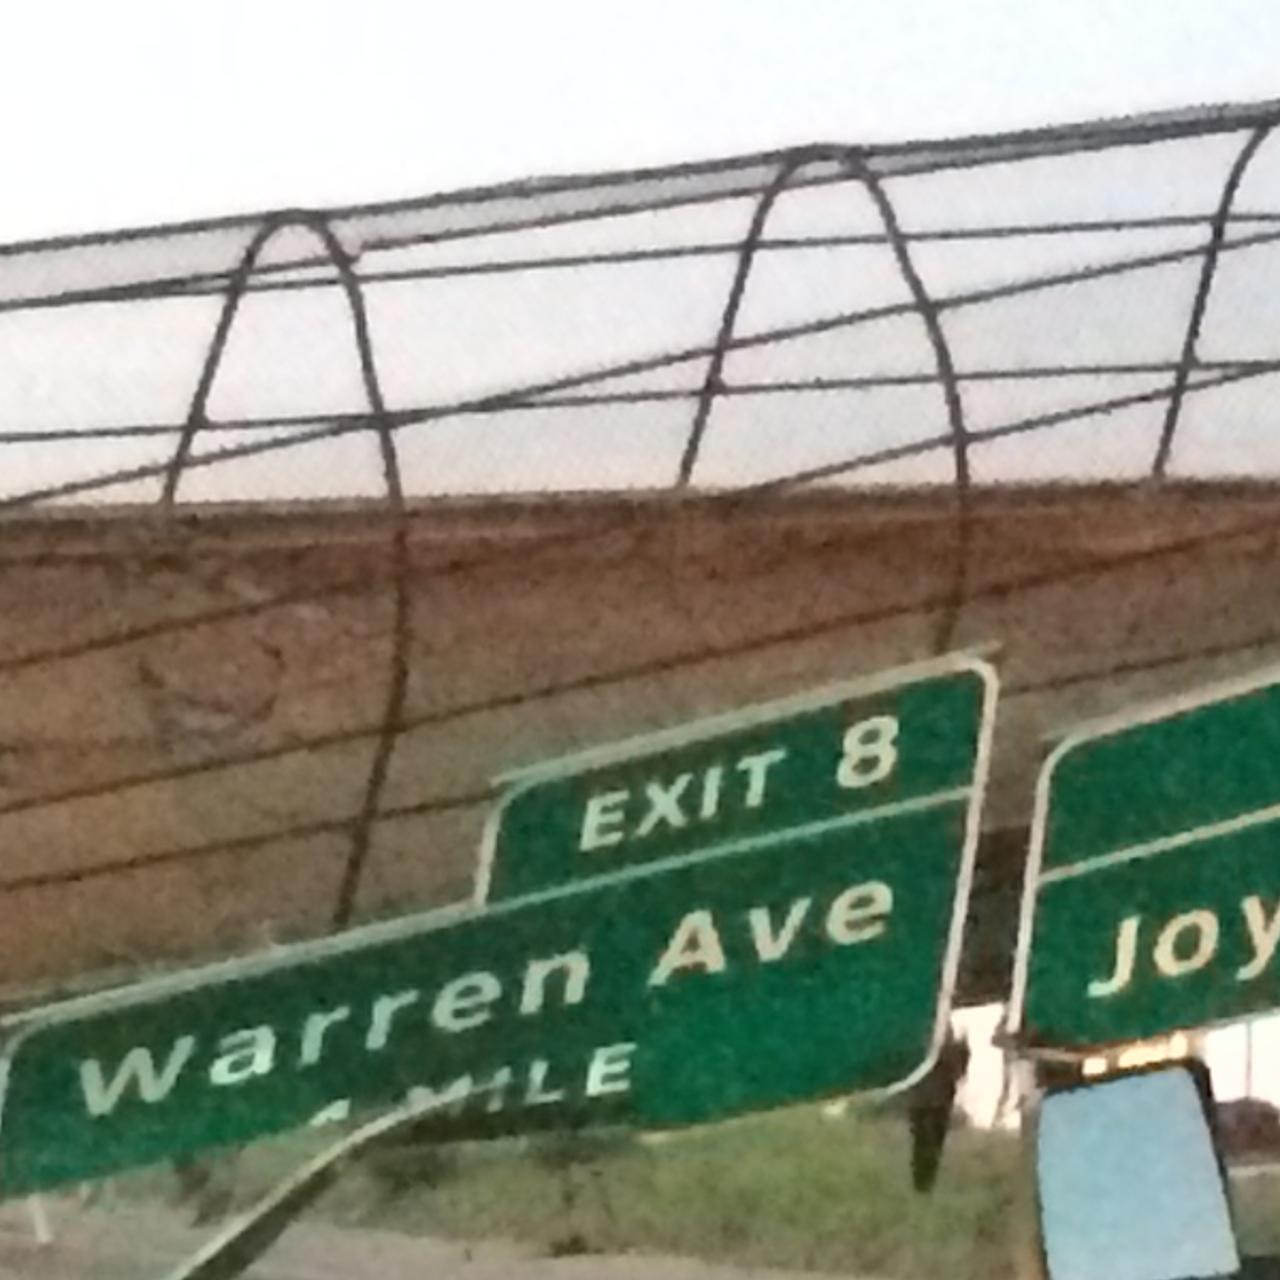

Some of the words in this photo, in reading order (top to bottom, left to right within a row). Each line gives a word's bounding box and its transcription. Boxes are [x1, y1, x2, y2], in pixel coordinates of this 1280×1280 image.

[579, 750, 784, 851] EXIT
[836, 715, 900, 789] 8
[78, 948, 591, 1115] Warren
[649, 879, 895, 988] Ave
